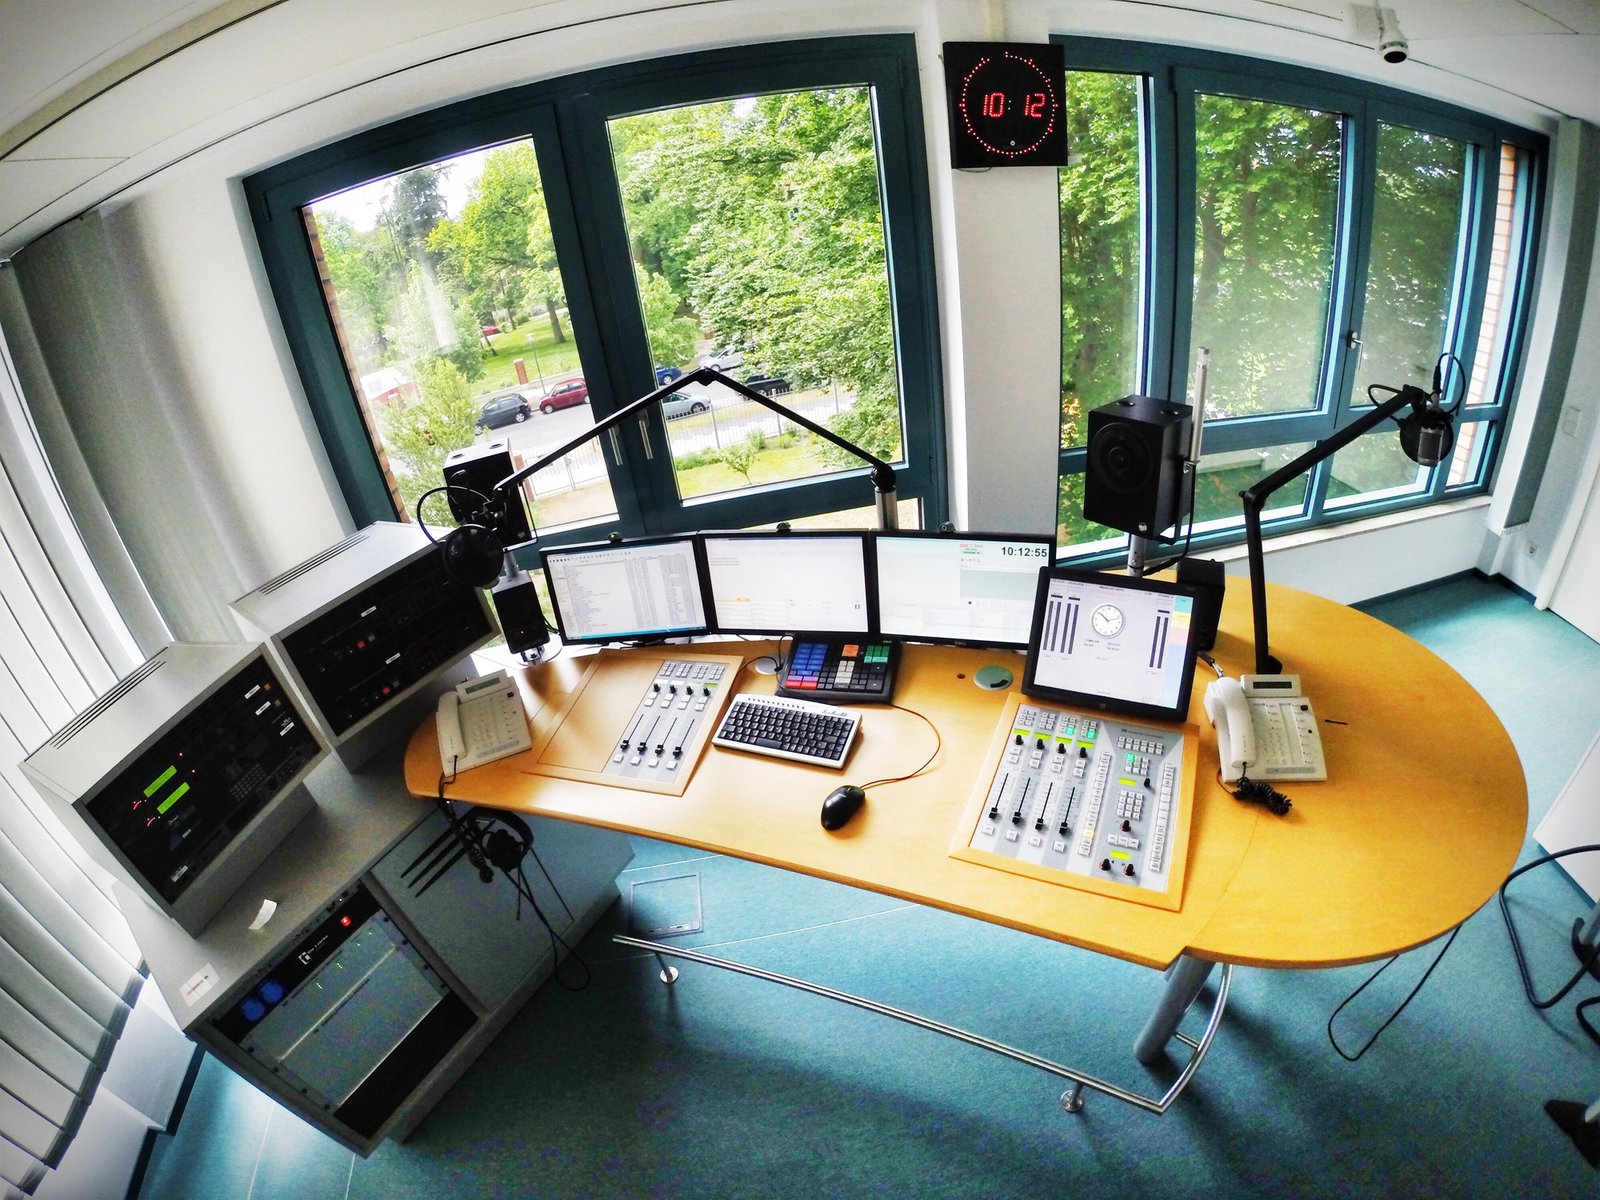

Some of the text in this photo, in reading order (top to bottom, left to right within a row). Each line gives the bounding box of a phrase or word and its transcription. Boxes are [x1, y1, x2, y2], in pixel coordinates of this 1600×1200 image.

[983, 92, 1046, 118] 10 12
[1001, 546, 1048, 558] 10:12:55
